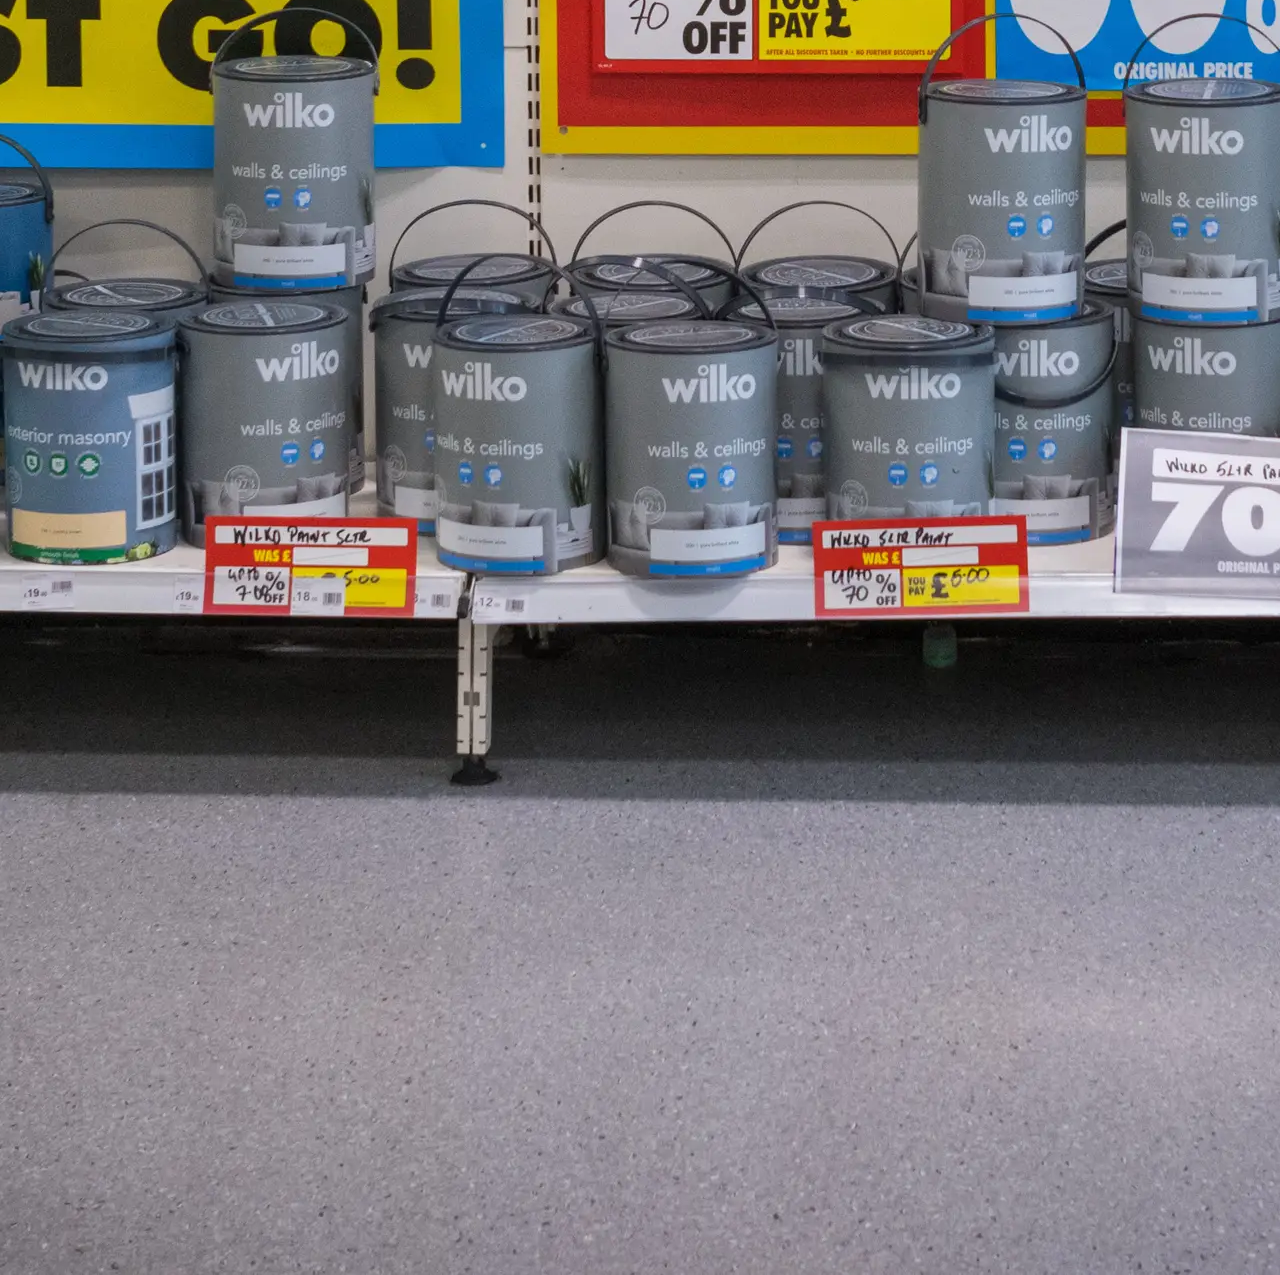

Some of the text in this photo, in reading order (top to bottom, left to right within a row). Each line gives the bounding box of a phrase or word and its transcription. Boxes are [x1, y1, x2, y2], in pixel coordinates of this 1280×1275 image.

[629, 0, 669, 34] 70
[768, 13, 816, 38] PAY
[682, 22, 747, 56] OFF
[1114, 62, 1253, 82] ORIGINAL PRICE
[243, 92, 335, 128] wilko
[984, 115, 1072, 153] wilko
[1150, 117, 1244, 155] wilko
[232, 163, 347, 182] walls & ceilings
[256, 342, 339, 382] wilko
[662, 364, 756, 403] wilko
[865, 366, 961, 400] wilko
[8, 427, 132, 447] exterior masonry
[852, 436, 973, 456] walls & ceilings
[1166, 458, 1207, 474] WILKO
[1217, 561, 1271, 575] ORIGINAL
[908, 578, 926, 586] YOU
[909, 587, 925, 595] PAY
[876, 596, 897, 606] OFF
